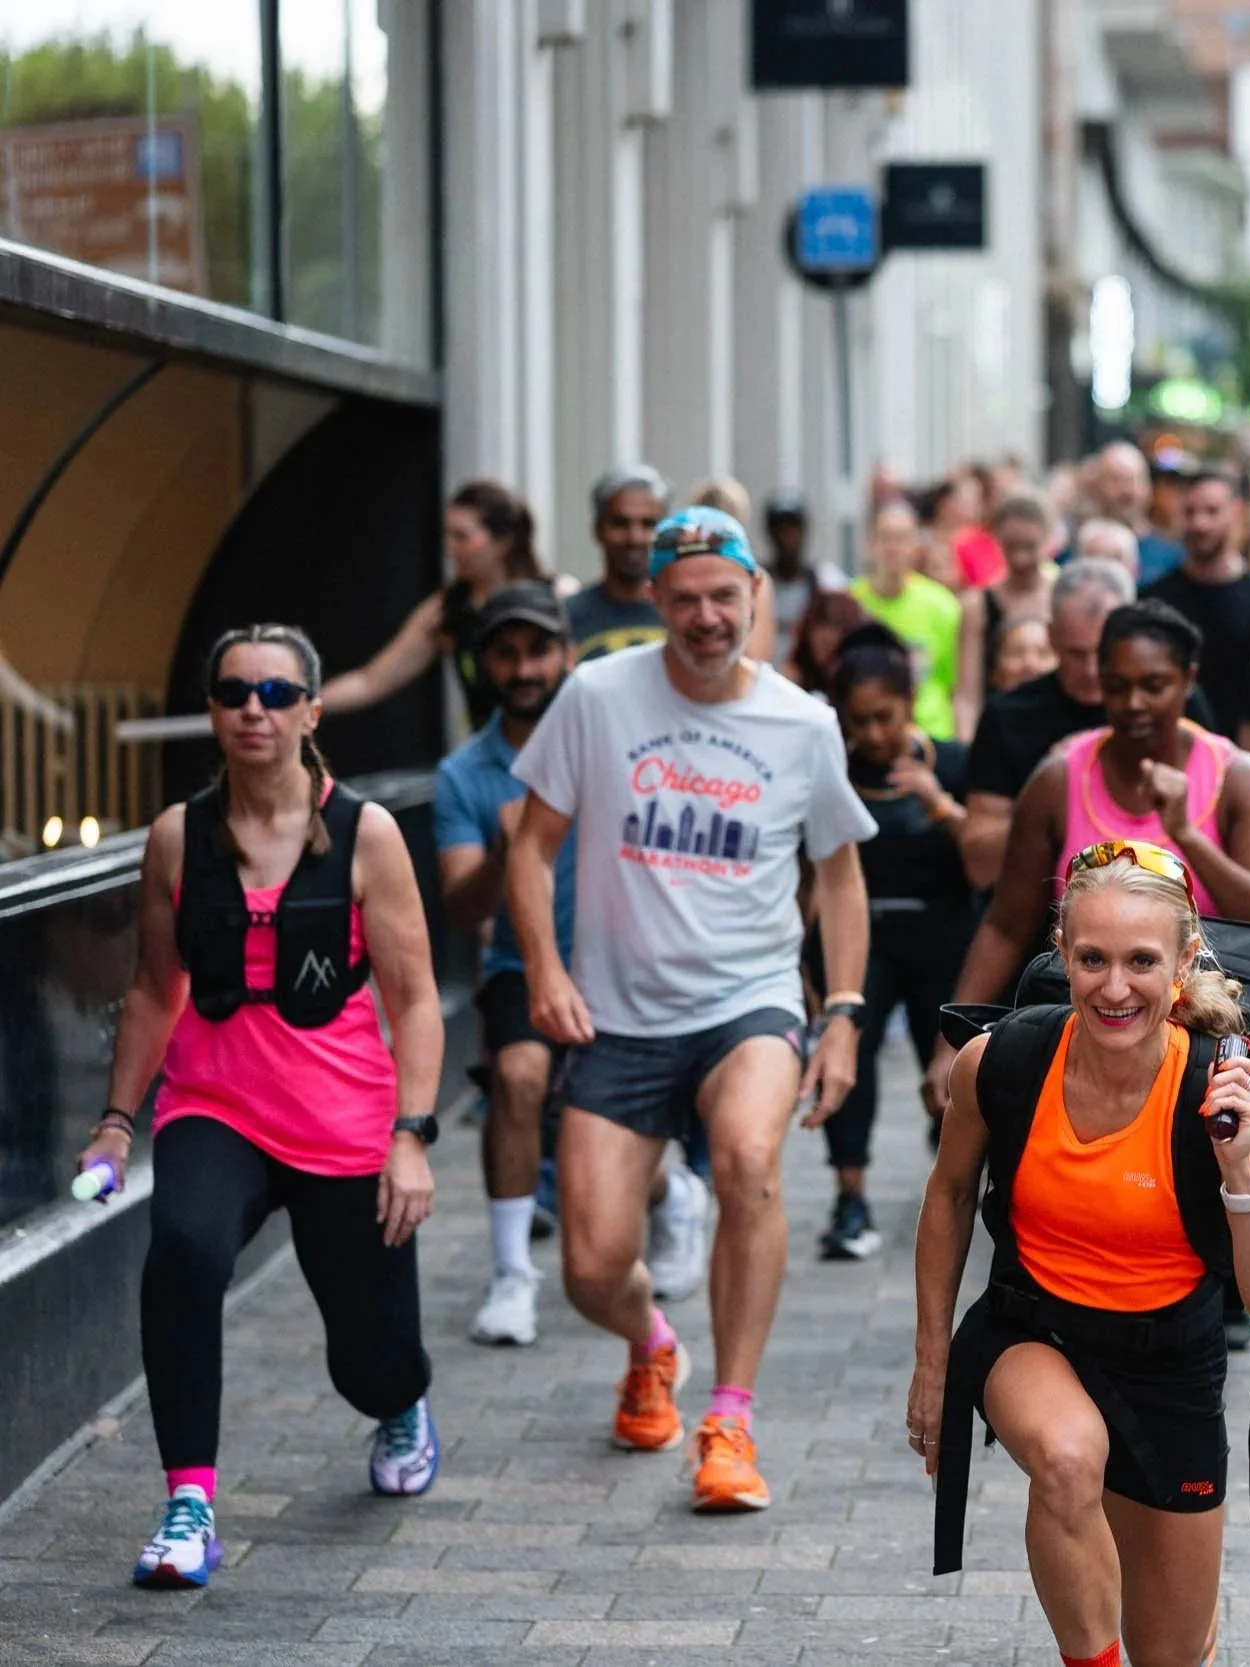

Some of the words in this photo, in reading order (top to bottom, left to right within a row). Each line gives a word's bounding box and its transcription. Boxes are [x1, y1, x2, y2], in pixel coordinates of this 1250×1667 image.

[628, 734, 673, 761] BANK
[680, 730, 702, 745] OF
[709, 734, 773, 783] AMERICA
[631, 756, 762, 810] Chicago
[619, 845, 728, 876] MARATHON
